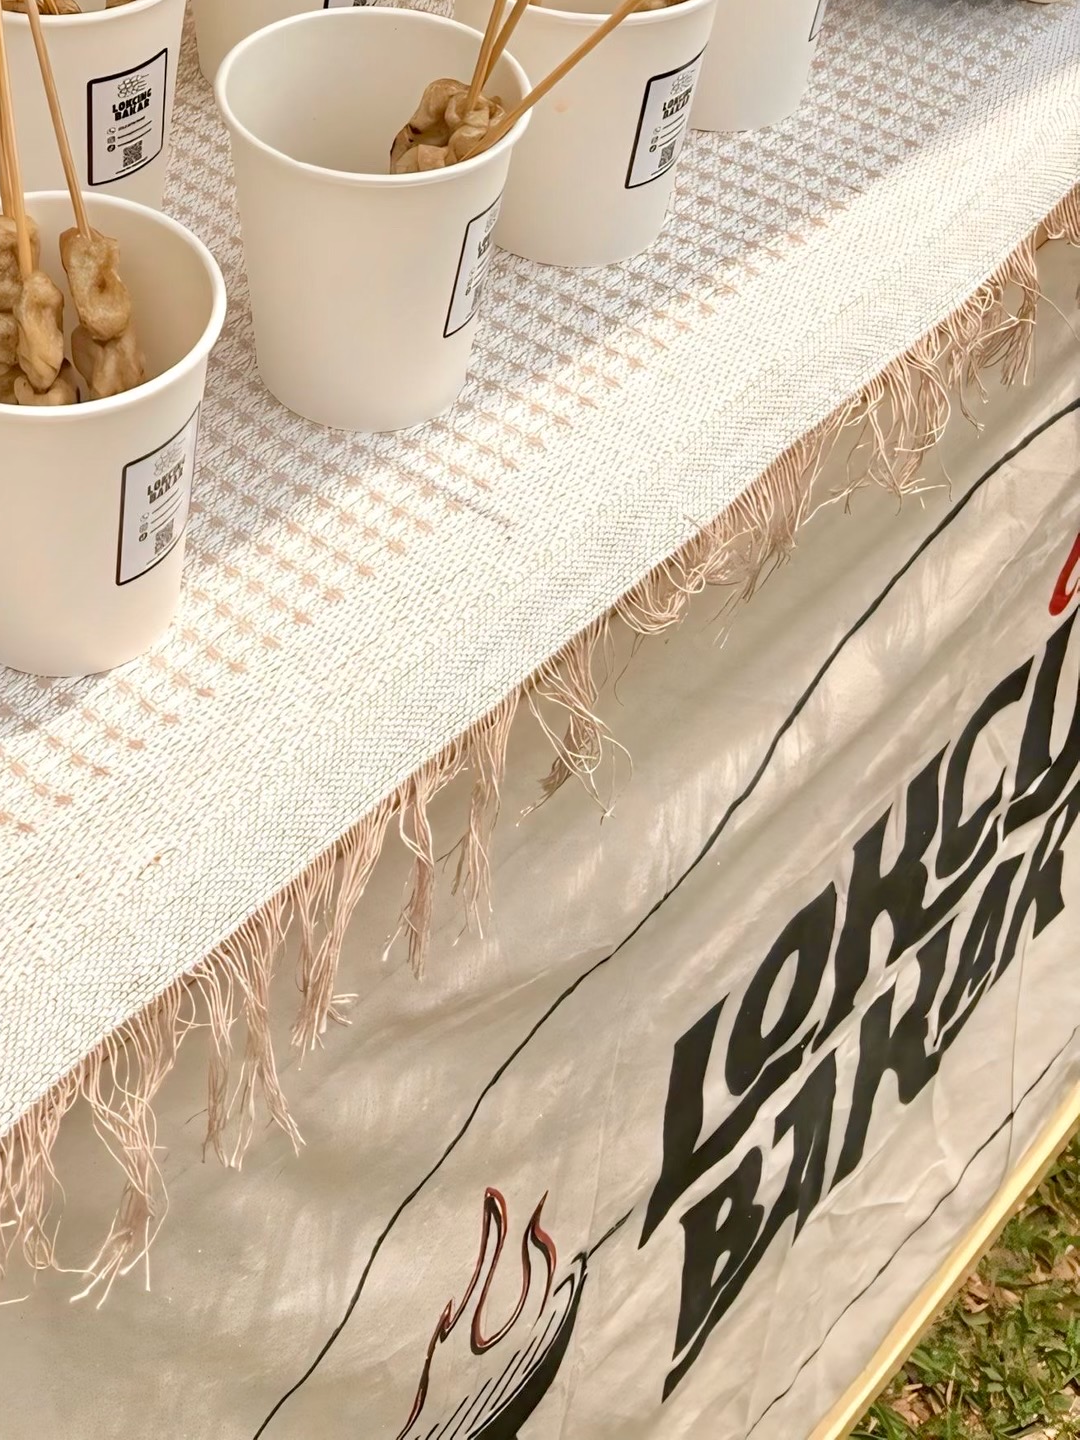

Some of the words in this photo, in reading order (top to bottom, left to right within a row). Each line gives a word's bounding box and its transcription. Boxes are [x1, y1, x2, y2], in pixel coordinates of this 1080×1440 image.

[112, 88, 152, 113] LOKCING
[114, 98, 150, 122] BAKAR
[638, 603, 1080, 1250] LOKCI
